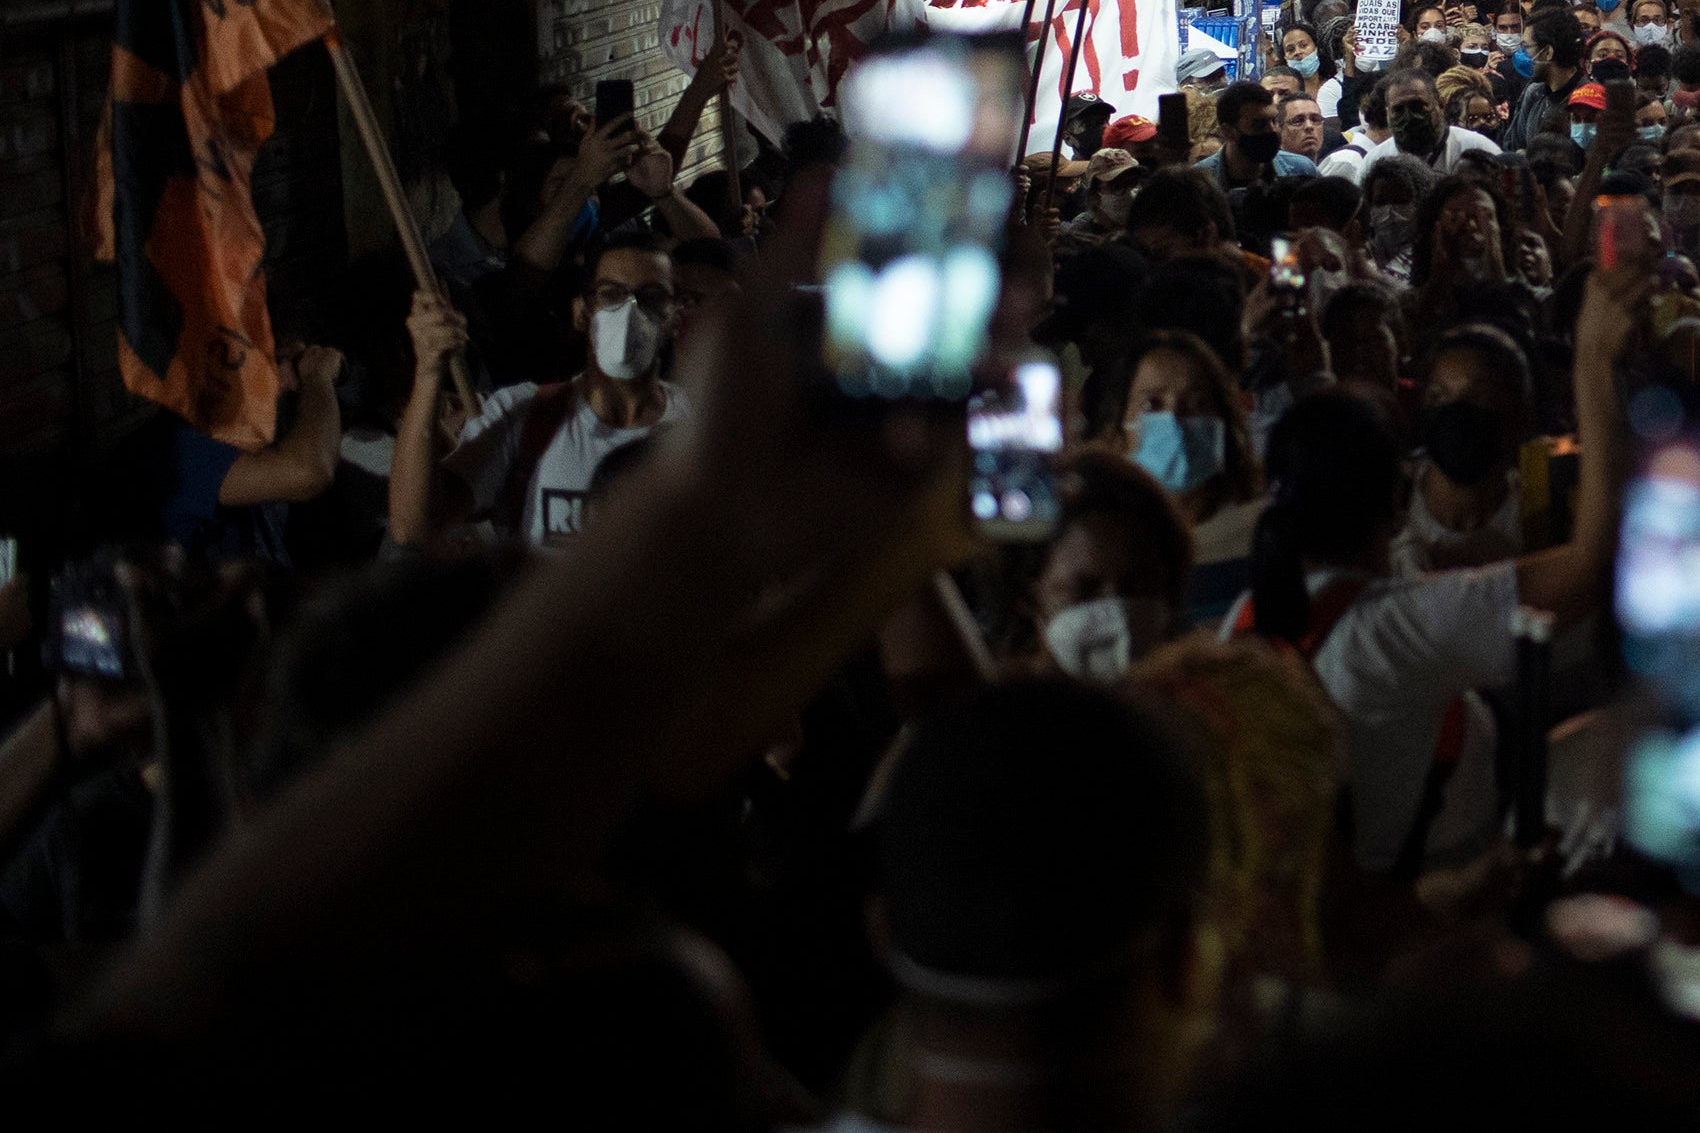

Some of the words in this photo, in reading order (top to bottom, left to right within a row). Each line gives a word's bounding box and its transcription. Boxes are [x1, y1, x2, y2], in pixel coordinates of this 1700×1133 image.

[1386, 0, 1397, 9] AS
[1381, 8, 1396, 16] QUE
[1355, 29, 1396, 37] ZINHO
[1355, 37, 1396, 45] PEDE
